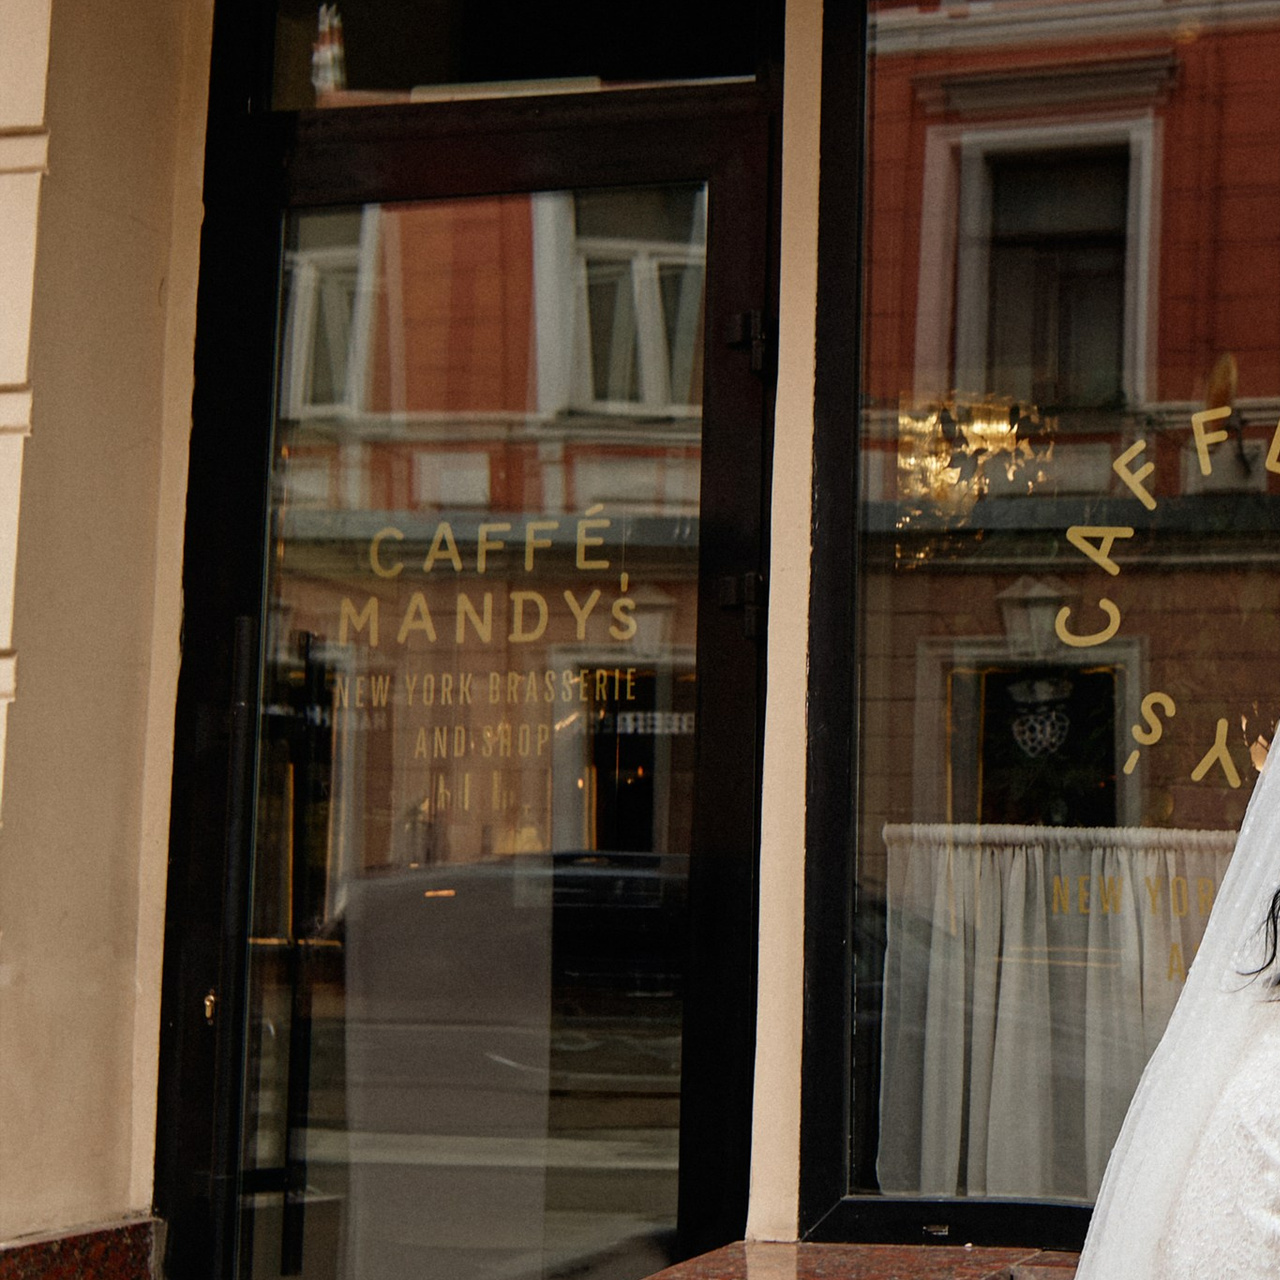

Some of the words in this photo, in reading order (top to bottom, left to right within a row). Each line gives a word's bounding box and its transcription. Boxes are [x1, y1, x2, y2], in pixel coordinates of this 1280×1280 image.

[369, 503, 611, 578] CAFFÉ
[337, 572, 638, 648] MANDY'S
[334, 673, 391, 709] NEW
[405, 672, 474, 707] YORK
[488, 668, 637, 705] BRASSERIE
[414, 725, 466, 759] AND
[481, 723, 549, 758] SHOP
[1052, 875, 1124, 915] NEW
[1145, 875, 1215, 917] YOR
